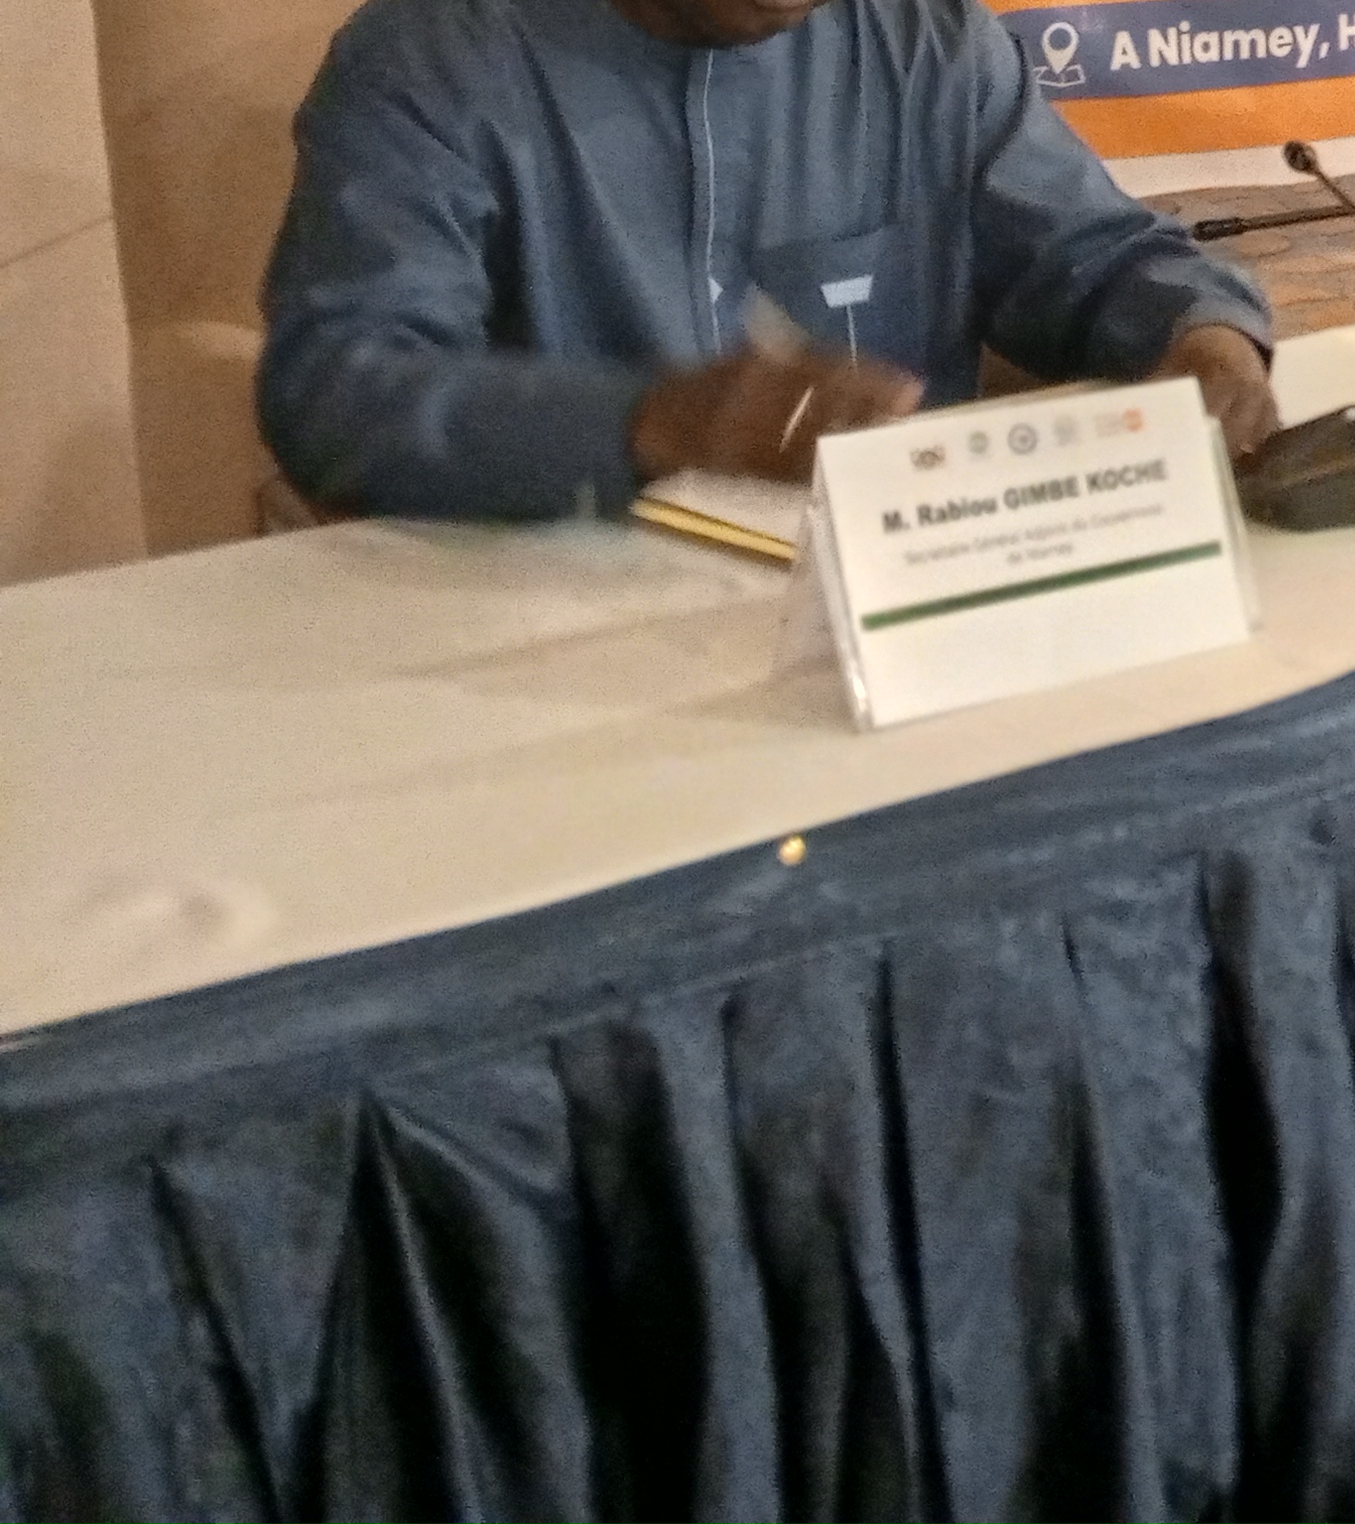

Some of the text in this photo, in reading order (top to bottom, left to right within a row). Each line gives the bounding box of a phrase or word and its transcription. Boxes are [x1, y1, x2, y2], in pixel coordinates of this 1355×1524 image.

[1109, 30, 1141, 71] A
[1147, 20, 1330, 69] Niamey,
[882, 509, 911, 534] M.
